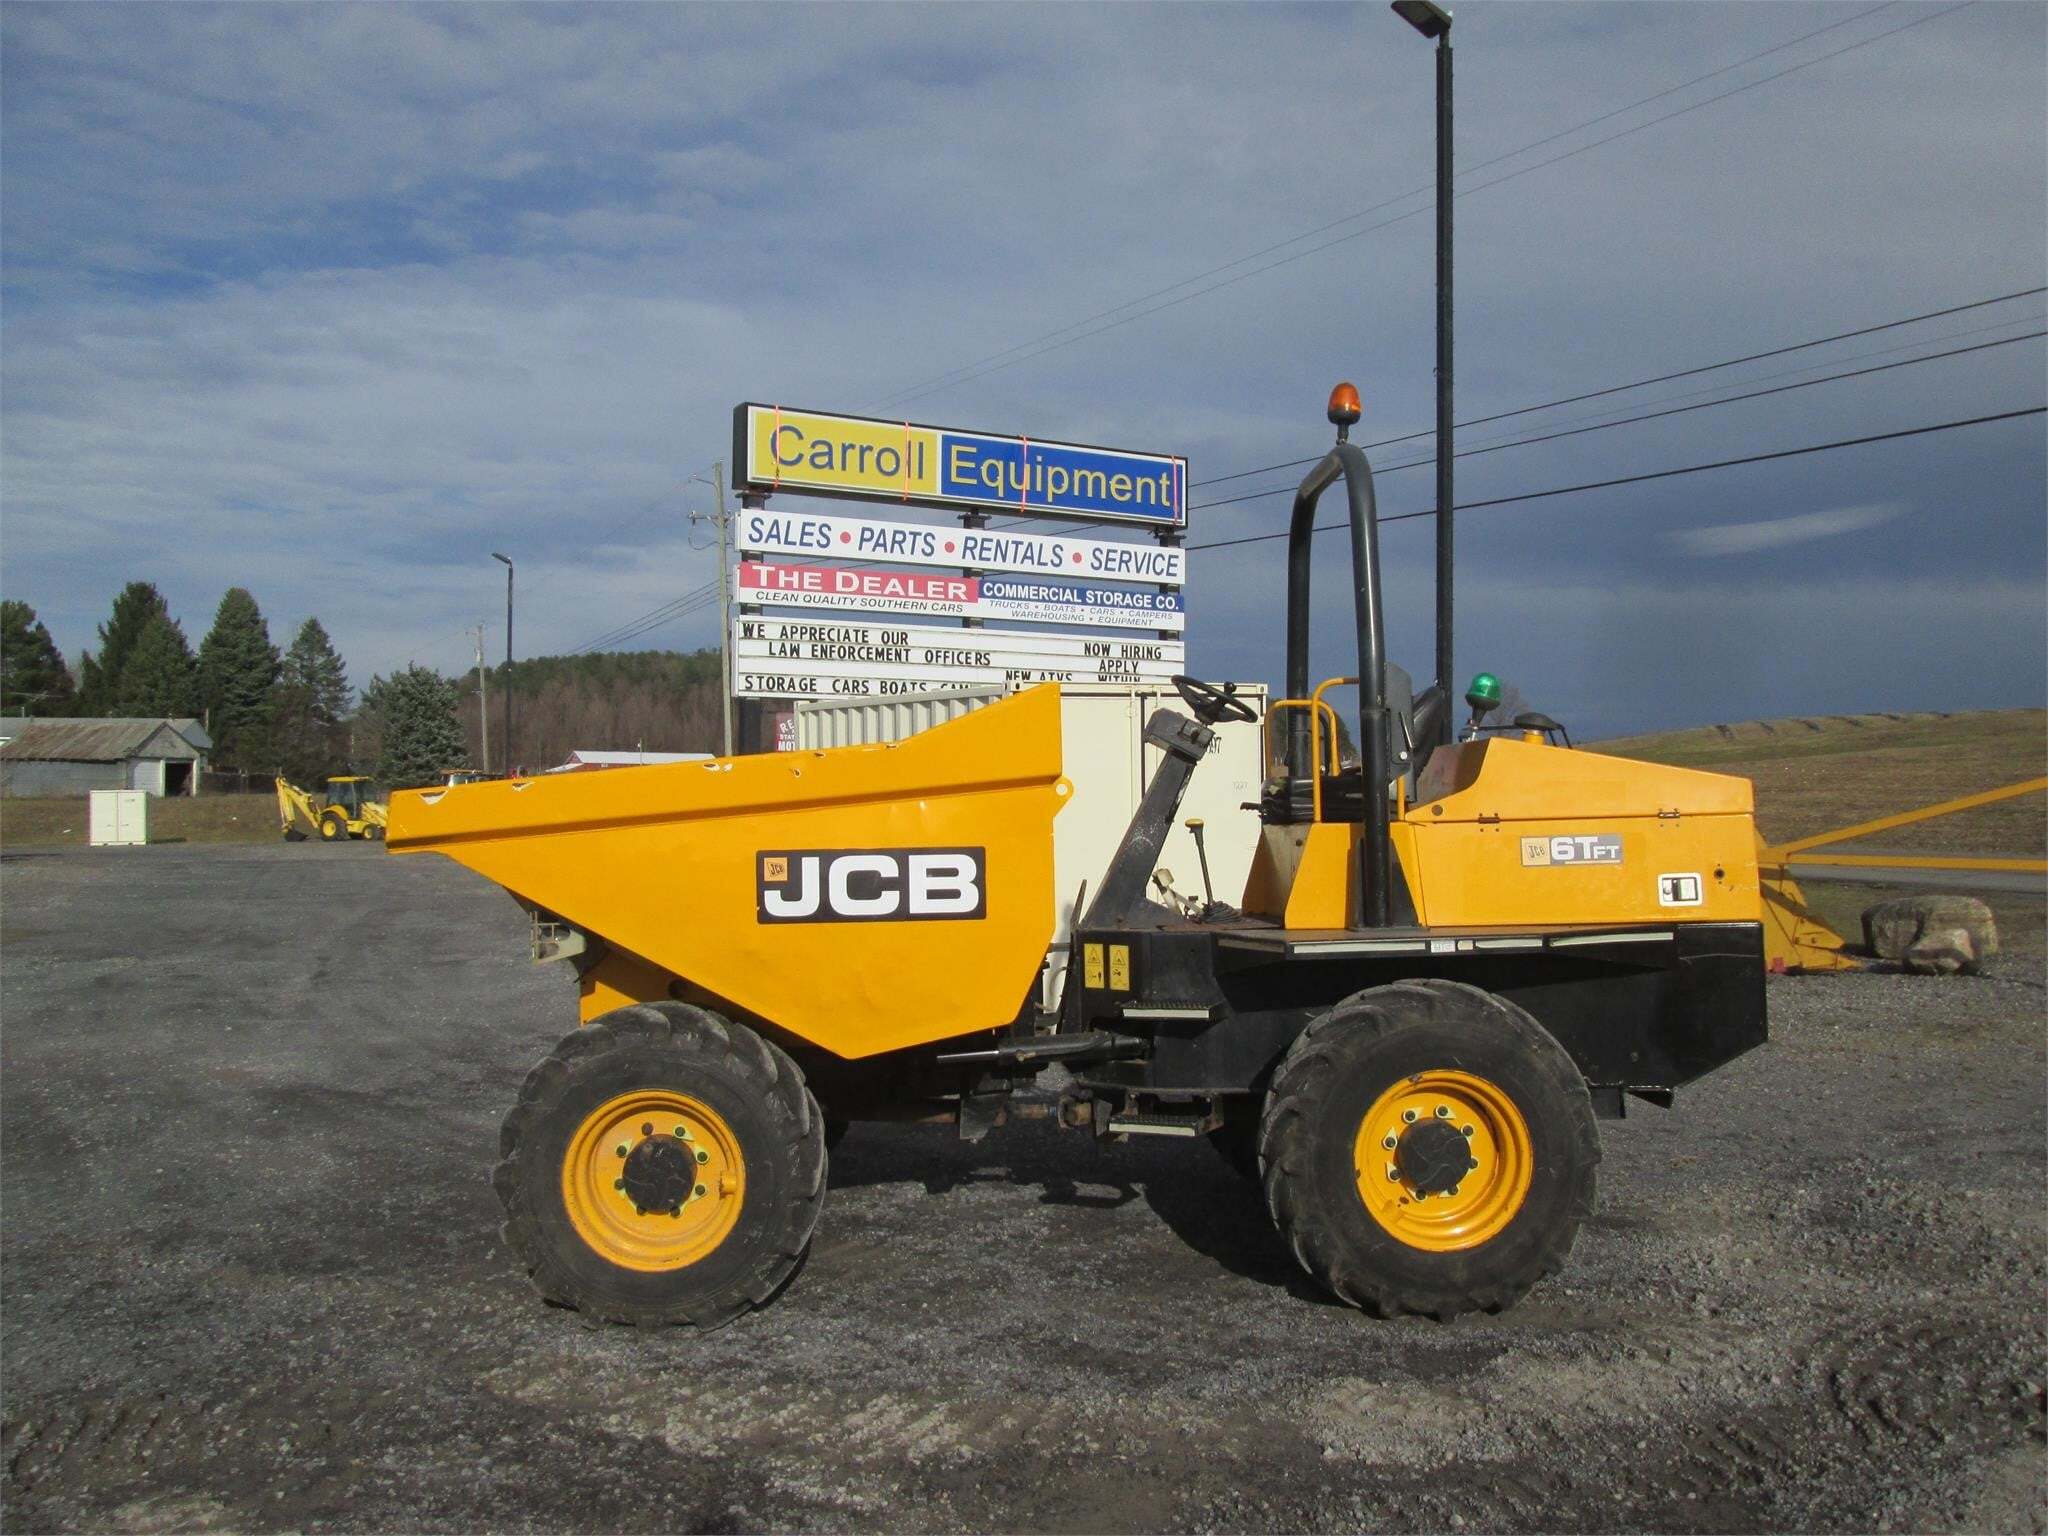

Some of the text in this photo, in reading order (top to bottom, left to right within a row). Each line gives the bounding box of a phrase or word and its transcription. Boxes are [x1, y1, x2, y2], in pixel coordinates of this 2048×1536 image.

[769, 425, 1171, 507] Carroll Equipment
[748, 517, 1180, 577] SALES PARTS RENTALS SERVICE
[752, 565, 968, 600] THE DEALER
[755, 591, 964, 613] CLEAN QUALITY SOUTHERN CARS
[982, 582, 1180, 610] COMMERCIAL STORAGE CO.
[989, 600, 1174, 620] TRUCKS BOATS CARS CAMPERS
[1011, 610, 1153, 627] WAREHOUSING EQUIPMENT
[742, 623, 909, 646] WE APPRECIATE OUR
[769, 642, 991, 666] LAW ENFORCEMENT OFFICERS
[1084, 642, 1162, 660] NOW HIRING
[1099, 659, 1139, 674] APPLY
[745, 675, 817, 692] STORAGE
[833, 678, 869, 694] CARS
[880, 680, 927, 695] BOATS
[1527, 845, 1546, 858] JCB
[763, 854, 980, 918] JCB
